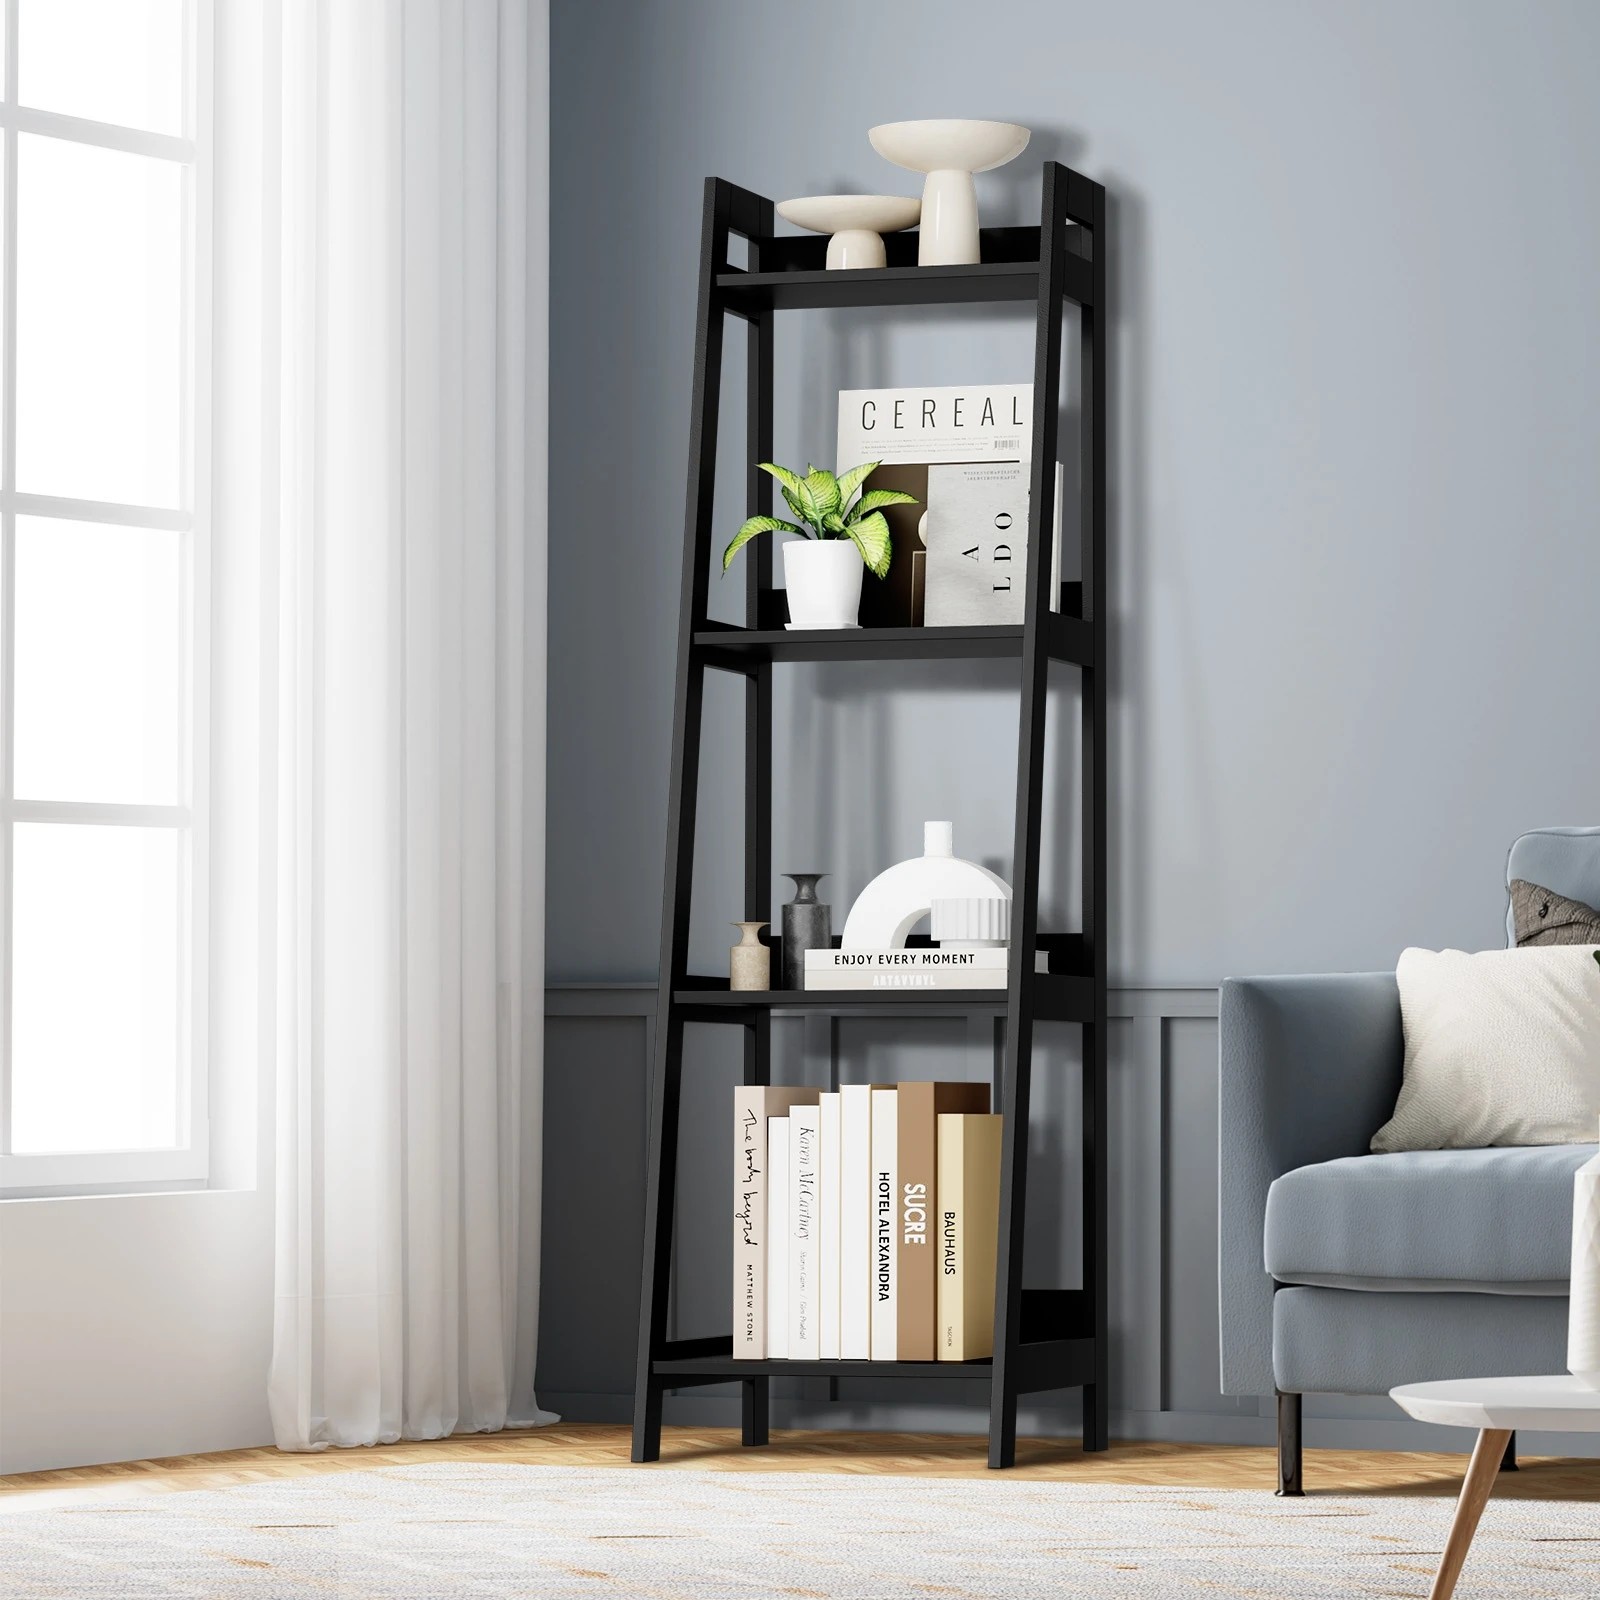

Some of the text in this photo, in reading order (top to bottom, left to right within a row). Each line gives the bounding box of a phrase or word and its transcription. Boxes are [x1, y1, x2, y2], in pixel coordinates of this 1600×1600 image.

[861, 396, 1024, 431] CEREAL
[961, 544, 980, 563] A
[834, 953, 976, 965] ENJOY EVERY MOMENT
[735, 1108, 761, 1247] The body beyond
[797, 1127, 814, 1240] Karen McCartney
[878, 1172, 890, 1302] HOTEL ALEXANDRA
[903, 1183, 926, 1245] SUCRE
[944, 1211, 956, 1276] BAUHAUS
[746, 1312, 754, 1342] STONE
